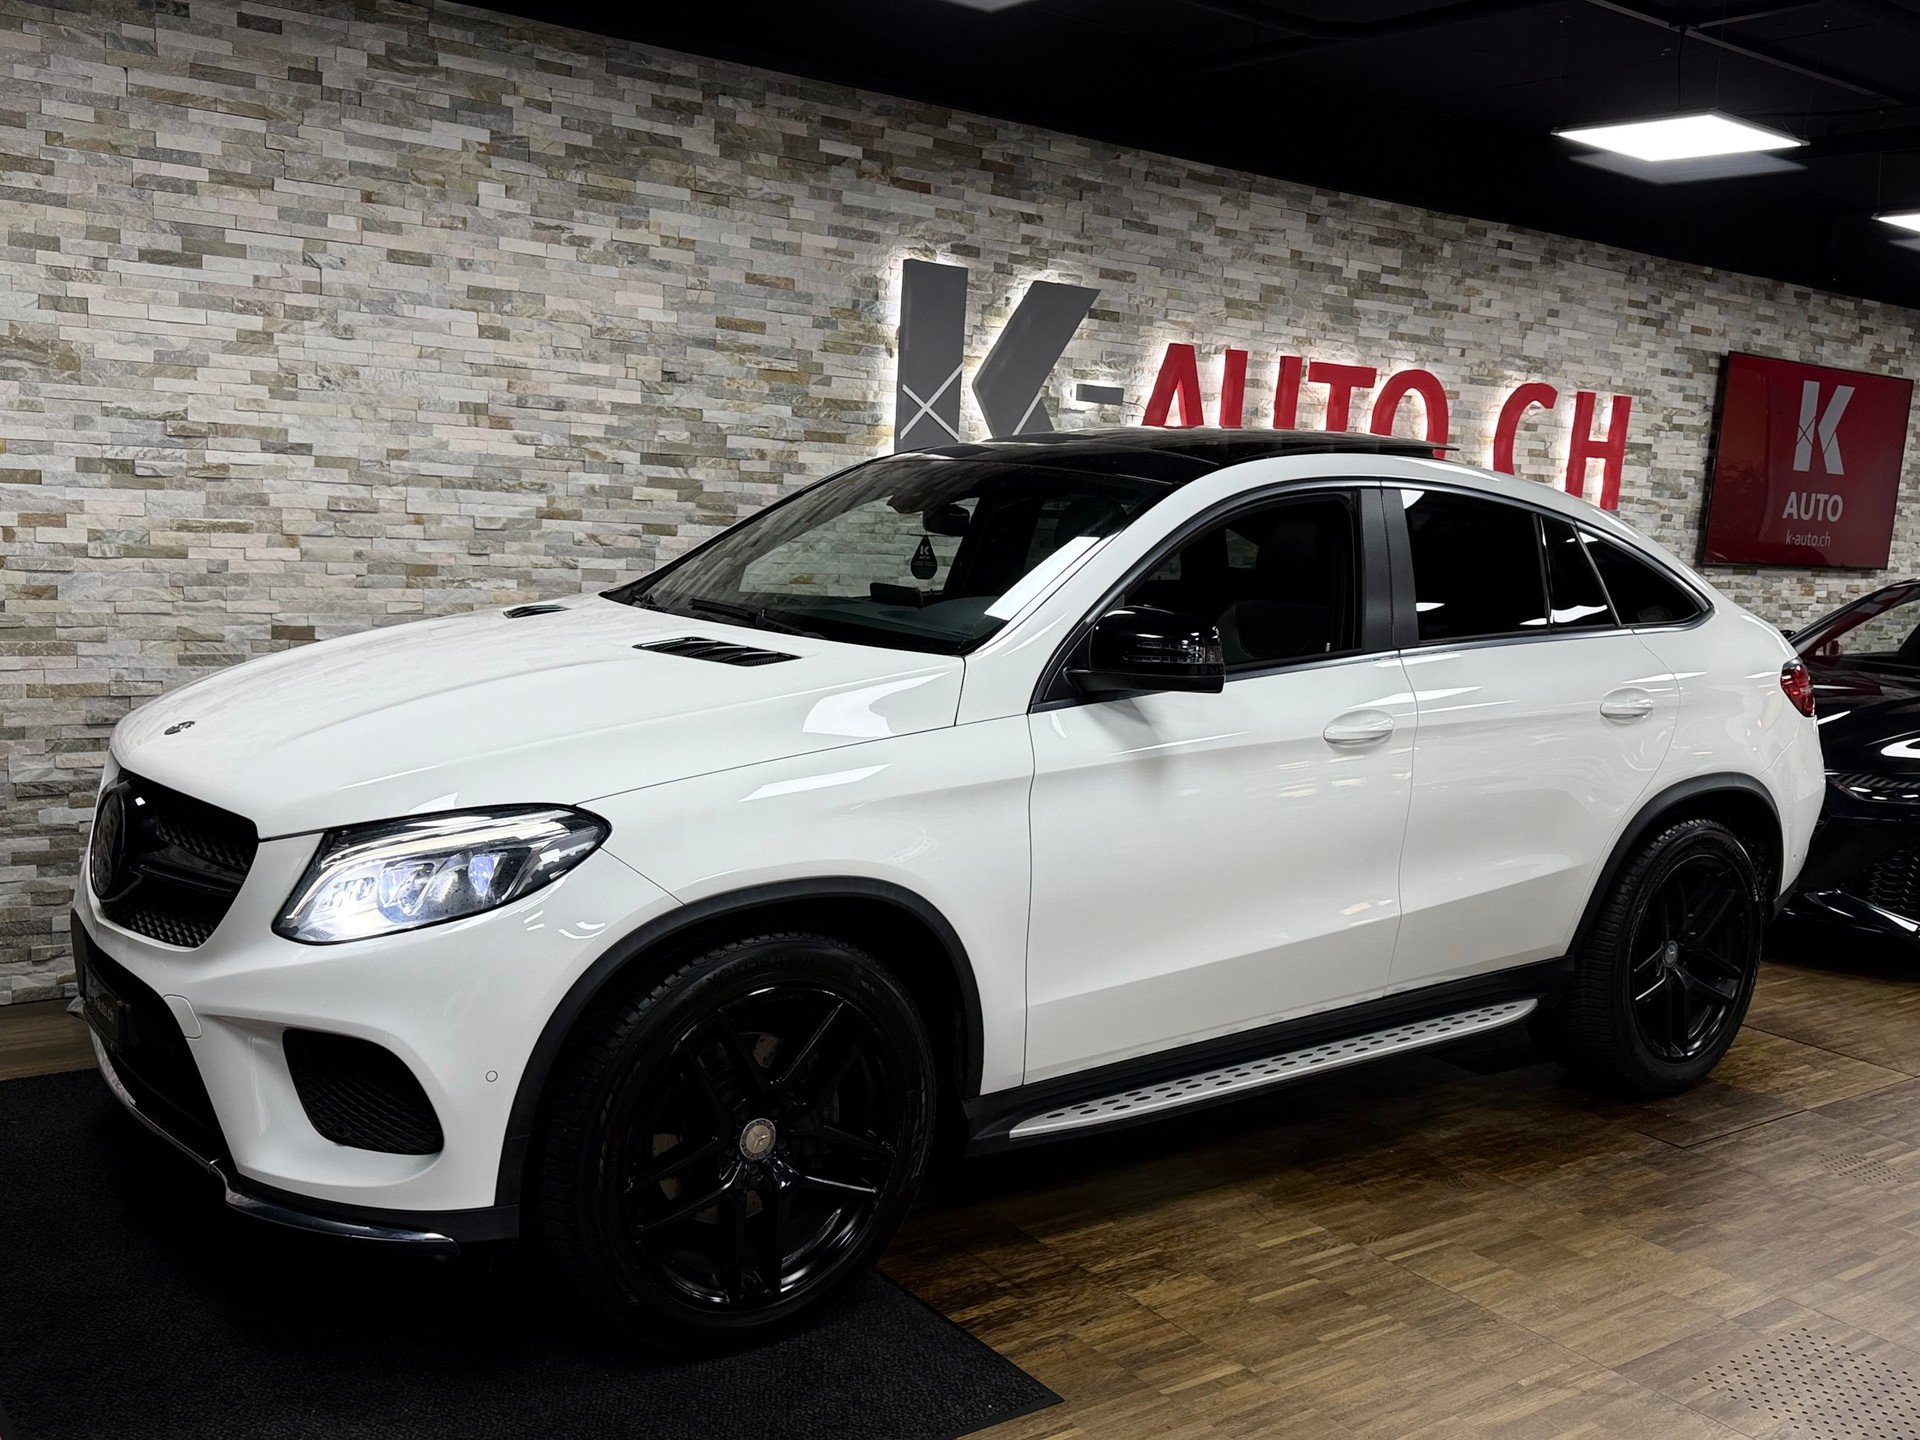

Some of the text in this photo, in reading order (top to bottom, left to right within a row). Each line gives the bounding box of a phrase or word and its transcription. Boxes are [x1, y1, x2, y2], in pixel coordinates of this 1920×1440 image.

[1793, 380, 1856, 476] K
[1782, 491, 1843, 522] AUTO
[1785, 529, 1831, 547] k-auto.ch
